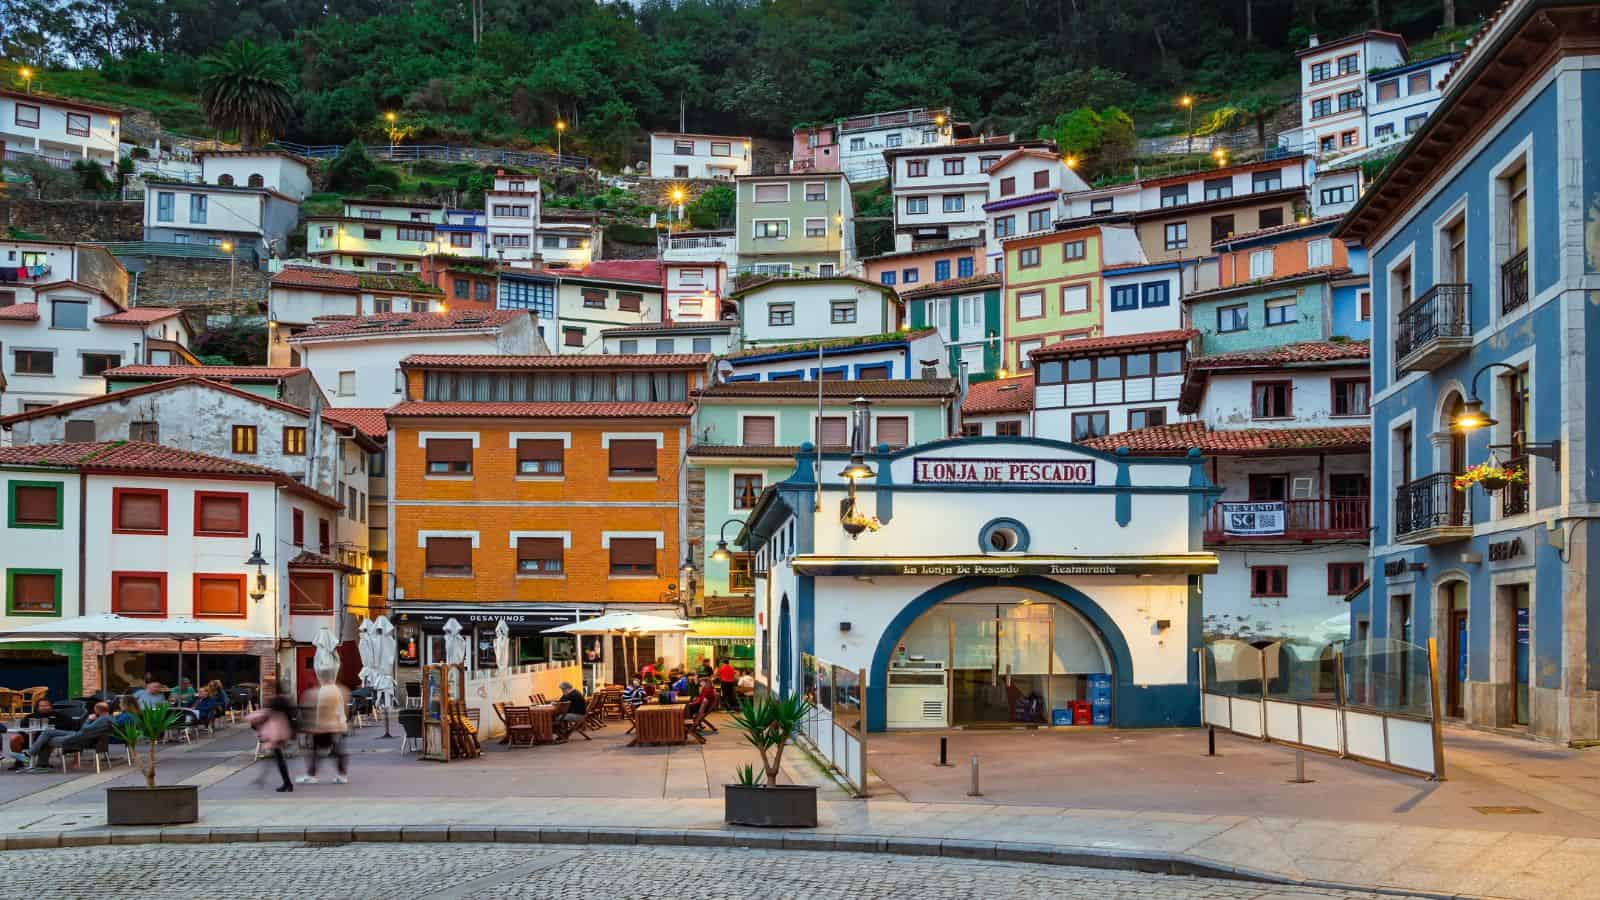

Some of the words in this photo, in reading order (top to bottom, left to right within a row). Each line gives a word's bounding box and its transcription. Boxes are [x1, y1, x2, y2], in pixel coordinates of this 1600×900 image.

[921, 463, 978, 481] LONJA
[984, 466, 1003, 481] DE
[1009, 464, 1088, 482] PESCADO
[903, 565, 917, 575] La
[921, 565, 953, 576] Lonja
[974, 565, 1019, 575] Pescado
[1051, 564, 1116, 575] Restaurante
